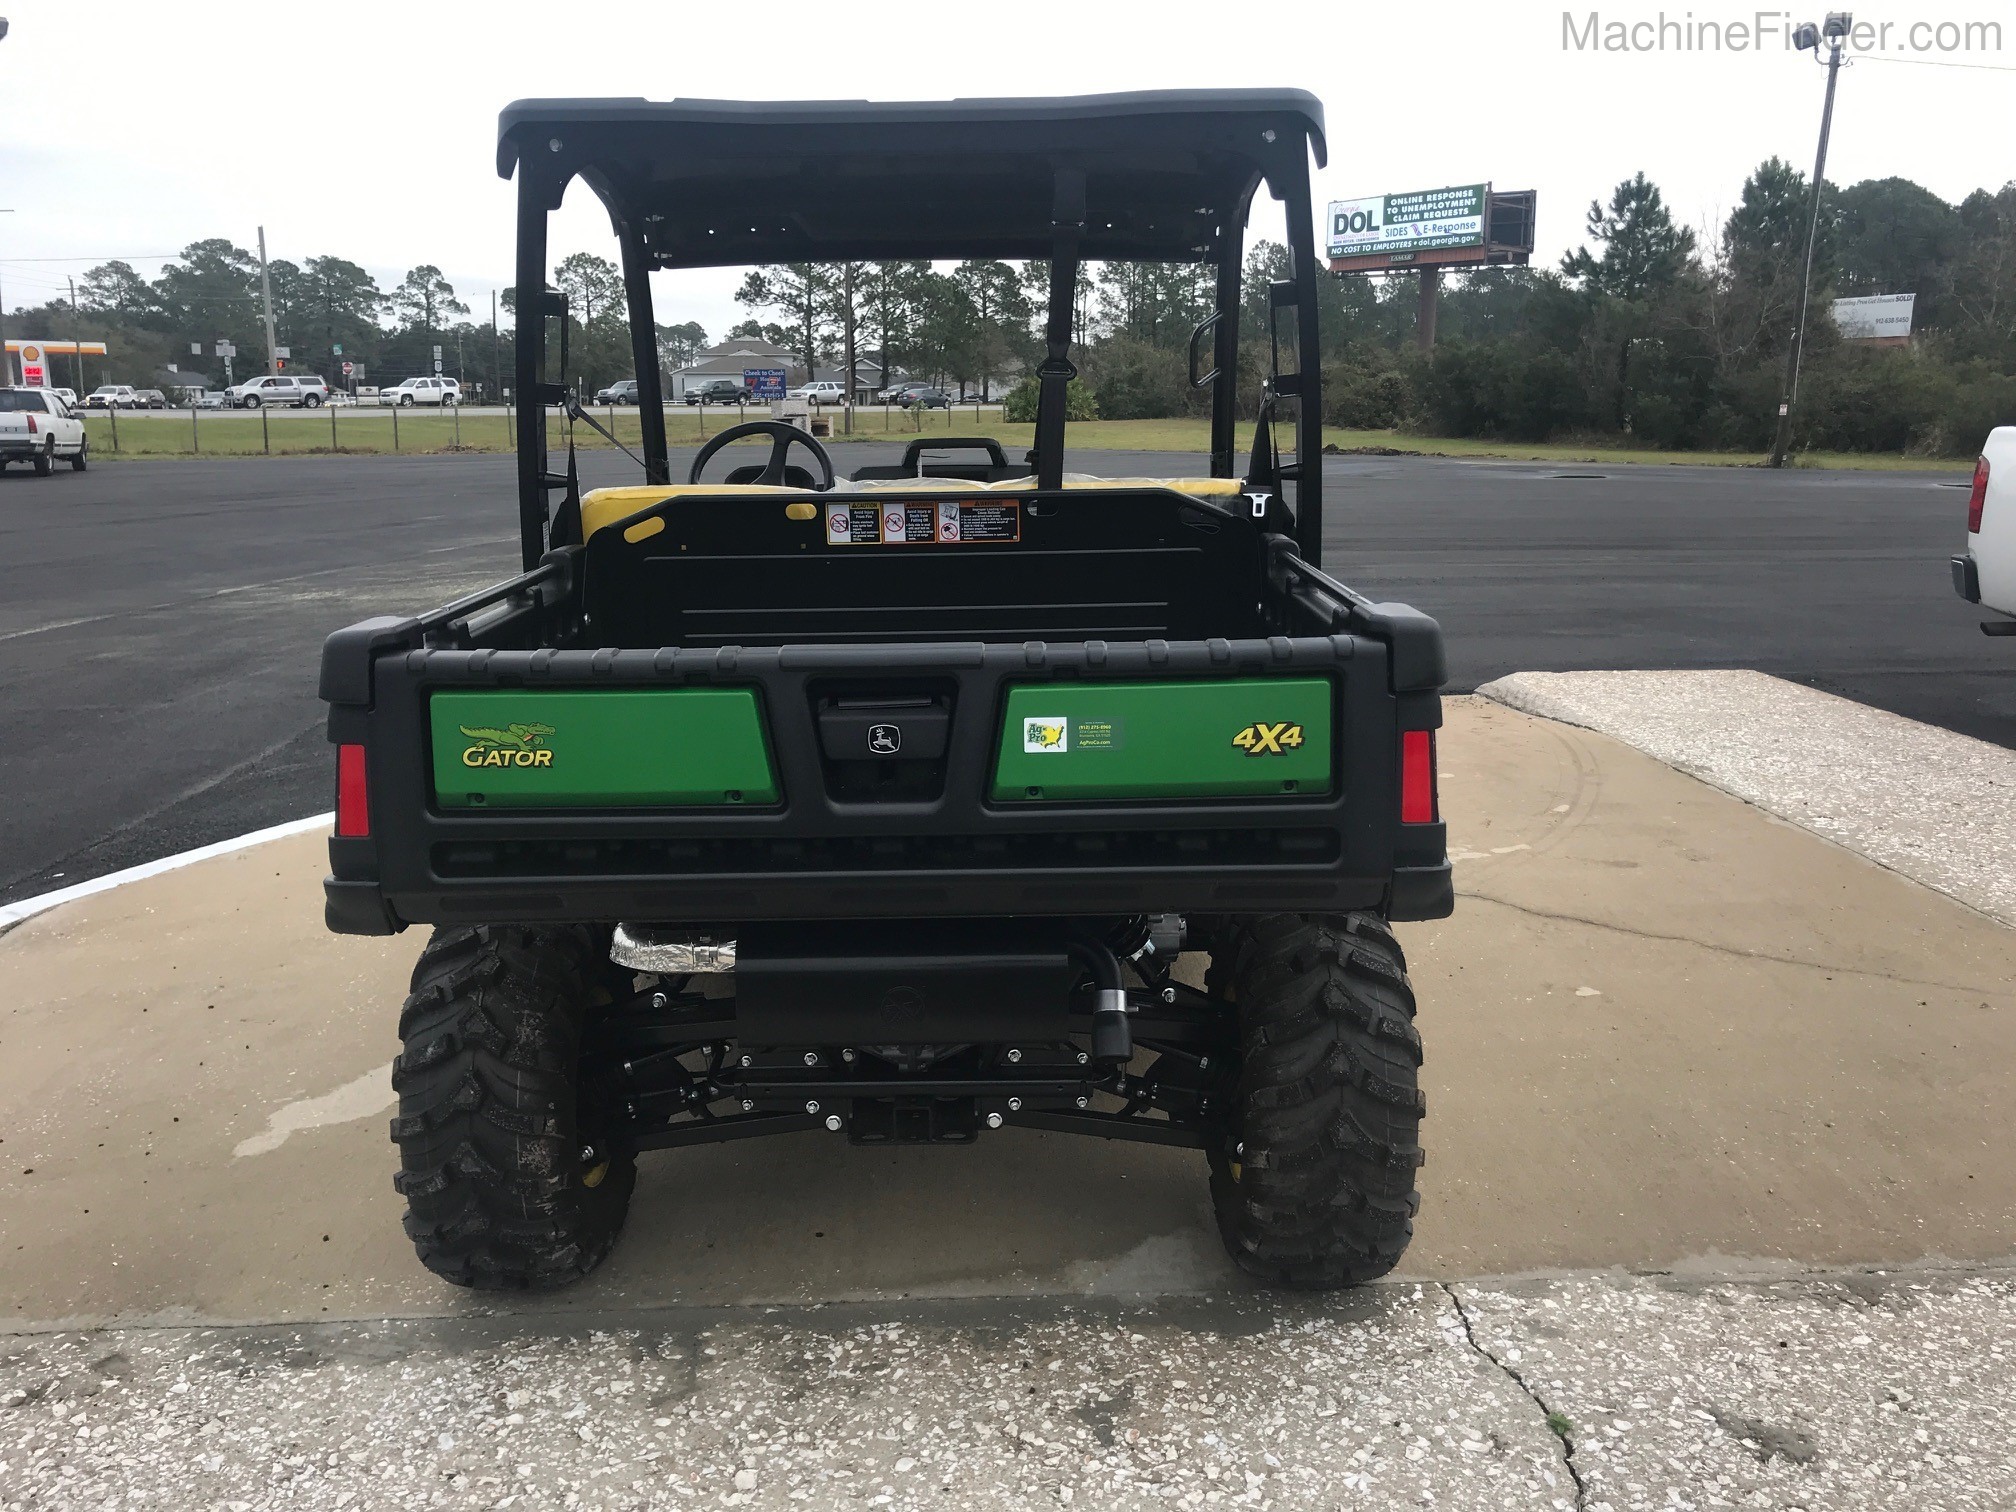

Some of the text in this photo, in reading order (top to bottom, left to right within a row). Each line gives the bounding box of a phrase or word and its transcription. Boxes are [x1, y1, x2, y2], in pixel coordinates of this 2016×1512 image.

[1386, 197, 1477, 215] TO UNEMPLOYMENT
[1390, 189, 1474, 206] ONLINE RESPONSE
[1333, 209, 1380, 236] DOL
[1392, 207, 1469, 223] CLAIM REQUESTS
[1385, 221, 1476, 238] SIDES E-Response
[1331, 235, 1476, 255] NO COST TO EMPLOYERS dol.georgia.gov
[1895, 294, 1913, 303] SOLD!
[1028, 733, 1047, 742] Pro
[1232, 722, 1303, 753] 4X4
[462, 746, 553, 767] GATOR
